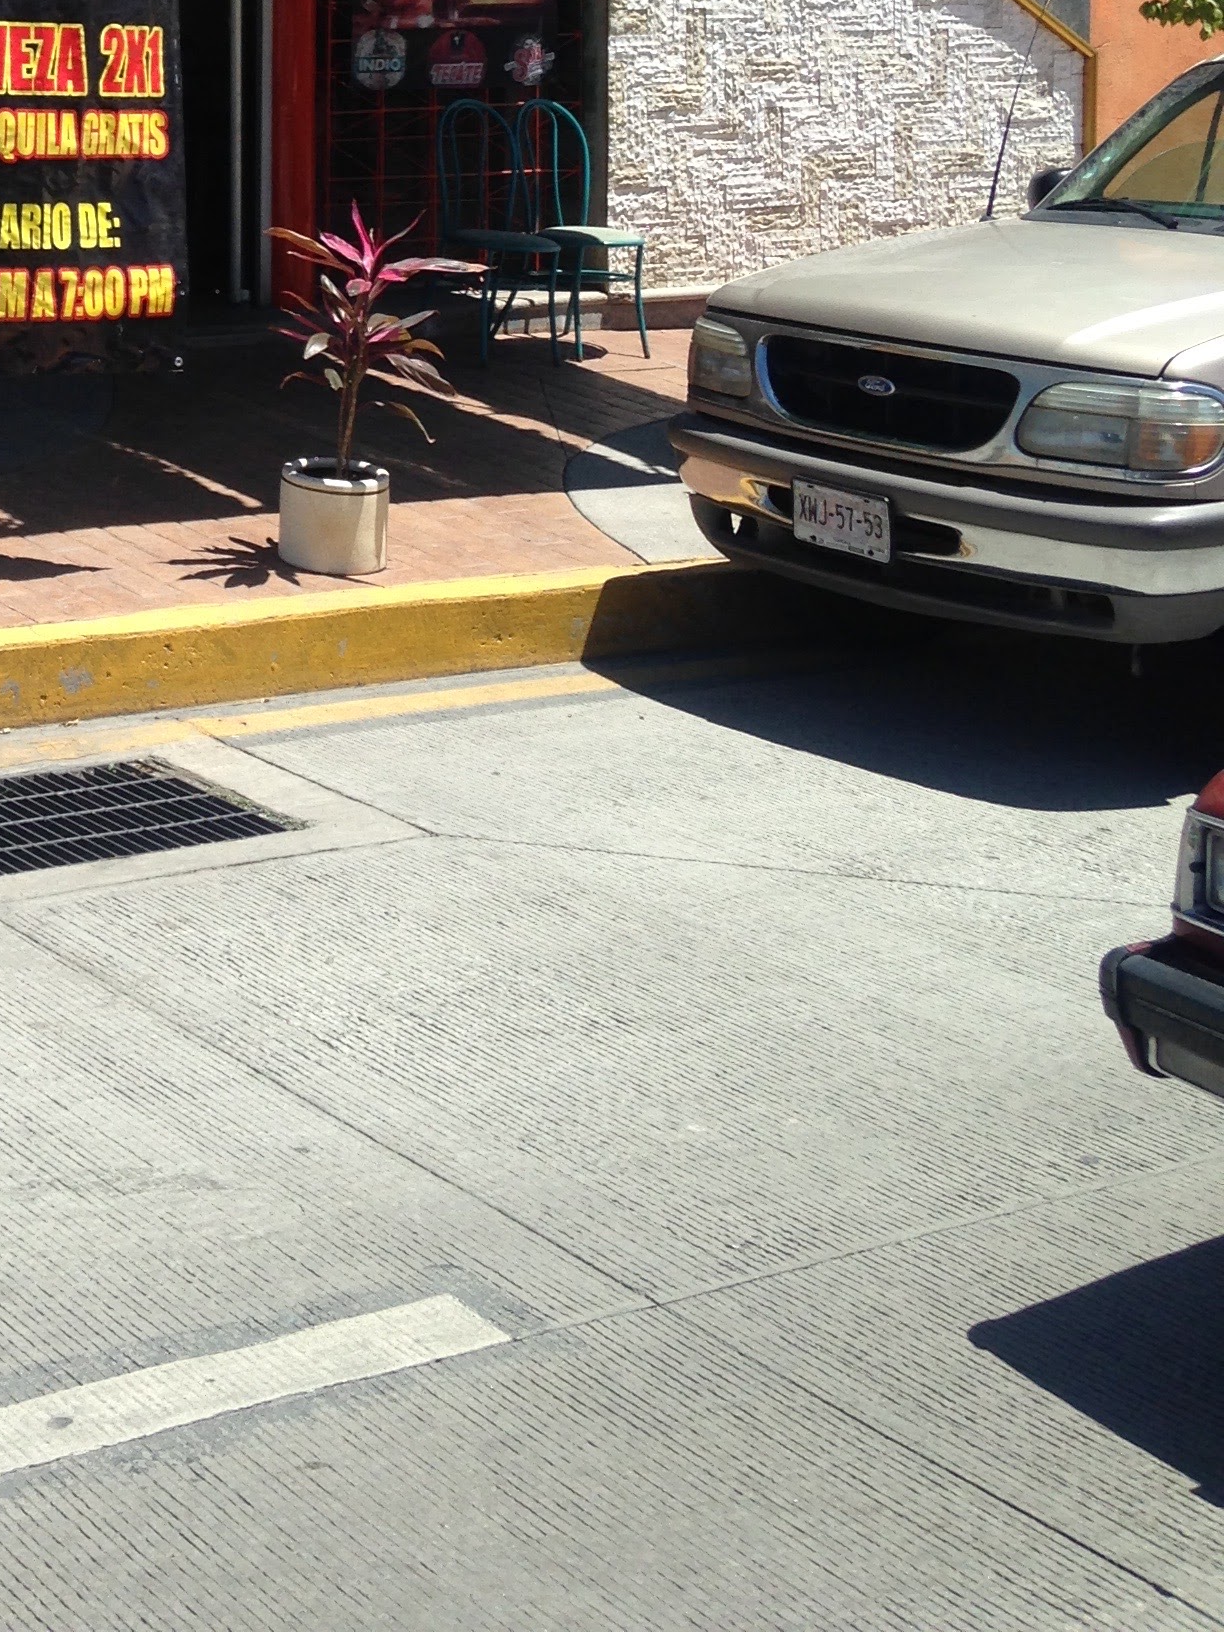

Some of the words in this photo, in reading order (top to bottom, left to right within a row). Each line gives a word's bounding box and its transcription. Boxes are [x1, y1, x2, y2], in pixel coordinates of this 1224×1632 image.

[99, 23, 165, 98] 2X1
[358, 58, 402, 72] INDIO
[80, 109, 170, 160] GRATIS
[78, 202, 122, 249] DE:
[30, 267, 59, 321] A
[59, 266, 126, 321] 7:00
[127, 264, 175, 319] PM
